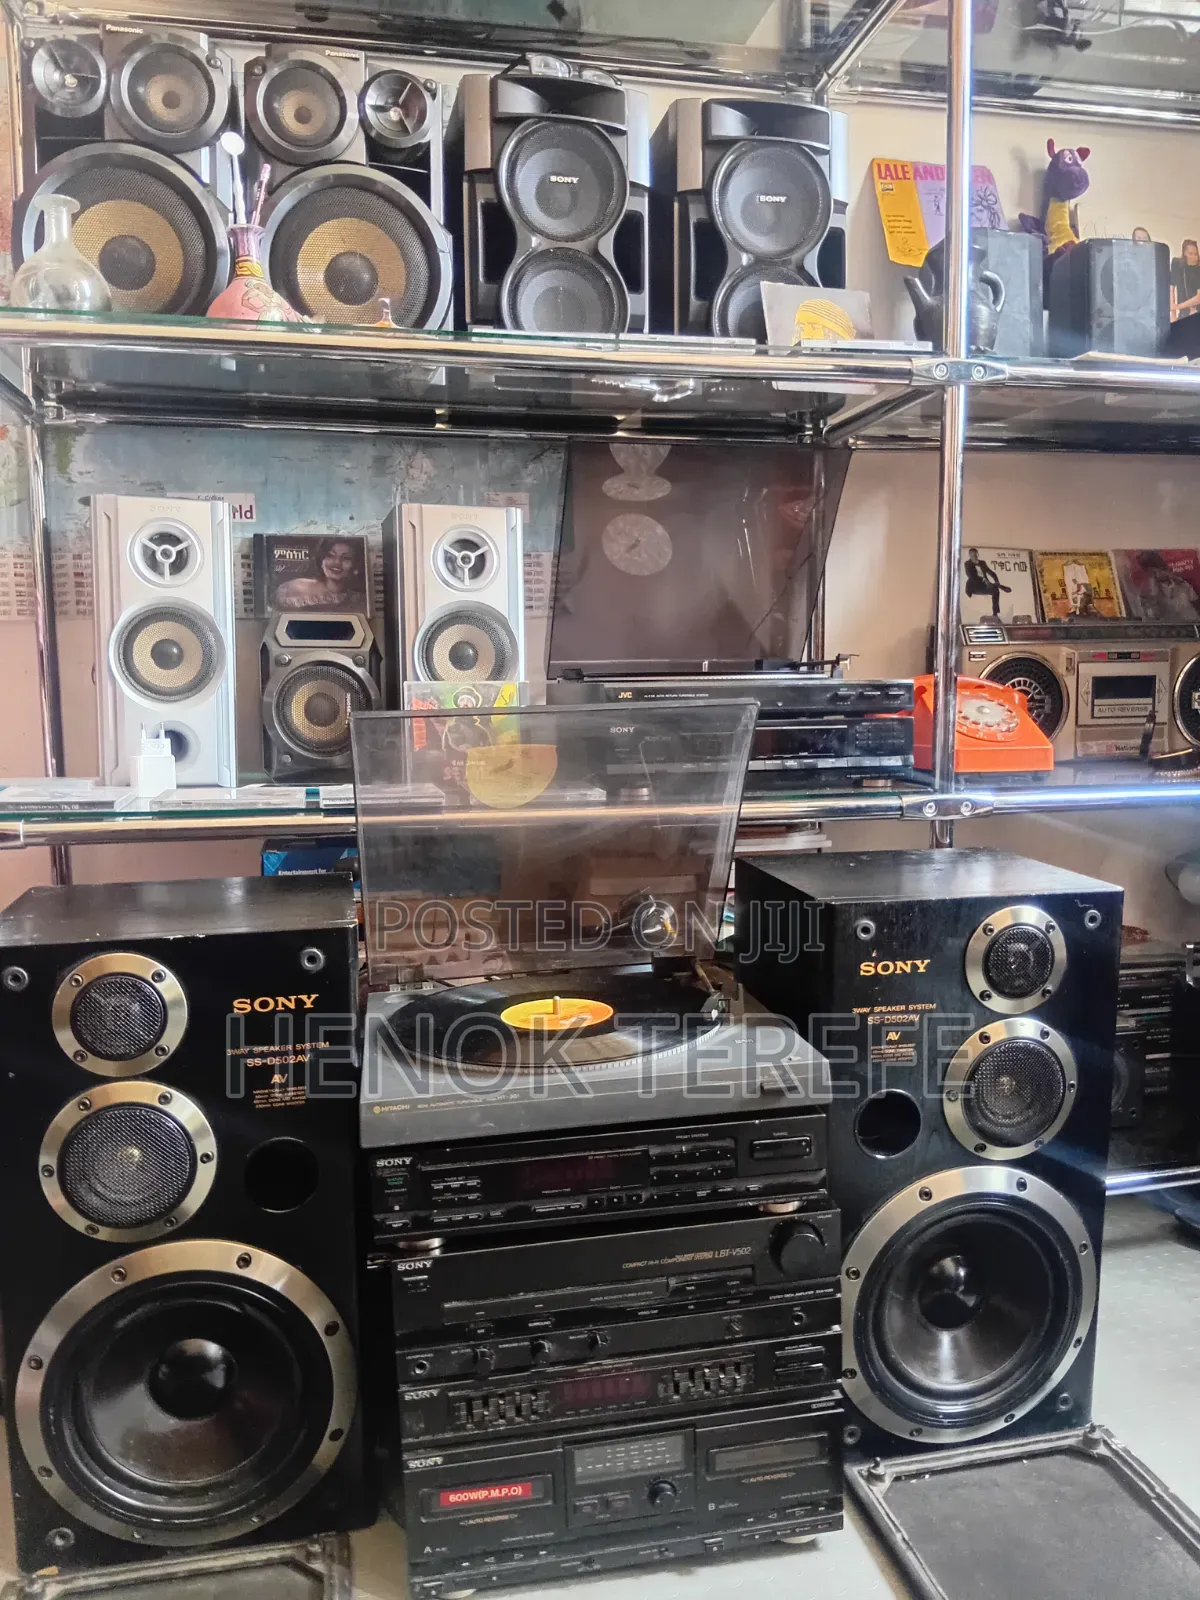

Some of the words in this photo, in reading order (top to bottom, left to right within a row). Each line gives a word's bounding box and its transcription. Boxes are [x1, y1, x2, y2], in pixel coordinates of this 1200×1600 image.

[105, 23, 143, 34] Panasonic
[325, 50, 360, 59] Panasonic
[876, 162, 911, 181] LALE
[549, 174, 579, 184] SONY
[758, 195, 787, 203] SONY
[618, 691, 633, 699] JVC
[860, 959, 931, 976] SONY
[232, 993, 320, 1014] SONY
[852, 1006, 871, 1014] 3WAY
[873, 1004, 906, 1013] SPEAKER
[908, 1003, 937, 1011] SYSTEM
[867, 1014, 920, 1025] SS-D502AV
[886, 1031, 901, 1041] AV
[226, 1047, 250, 1056] 3WAY
[253, 1044, 293, 1054] SPEAKER
[295, 1041, 330, 1051] SYSTEM
[246, 1053, 311, 1067] SS-D502AV
[270, 1073, 288, 1084] AV
[381, 1104, 410, 1112] HITACHI
[376, 1156, 413, 1168] SONY
[714, 1246, 752, 1258] LBT-V502
[396, 1259, 434, 1271] SONY
[404, 1388, 440, 1401] SONY
[407, 1456, 444, 1469] SONY
[449, 1485, 523, 1503] 600W(P.M.P.O)
[708, 1502, 716, 1511] B
[423, 1545, 432, 1553] A
